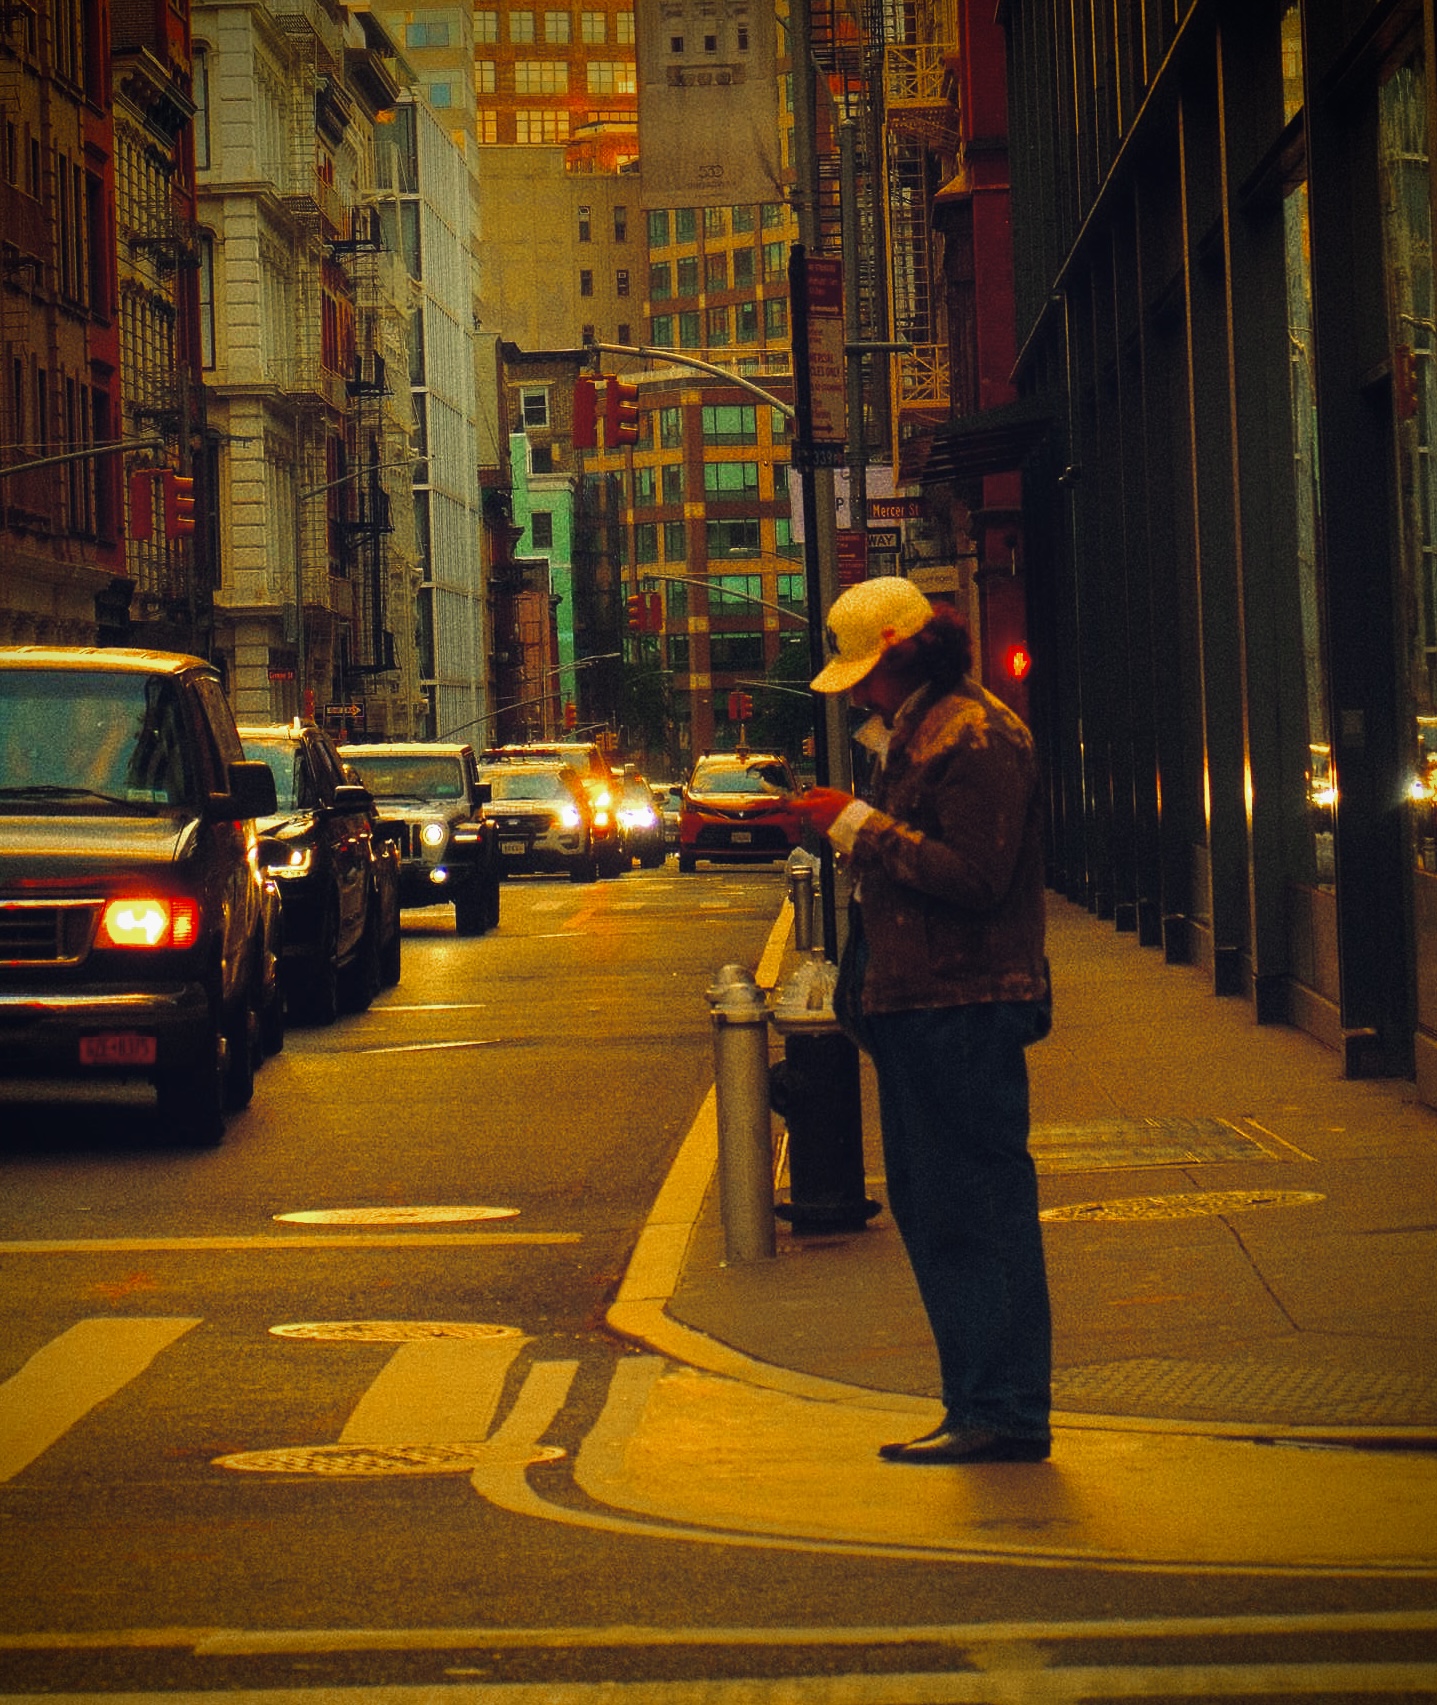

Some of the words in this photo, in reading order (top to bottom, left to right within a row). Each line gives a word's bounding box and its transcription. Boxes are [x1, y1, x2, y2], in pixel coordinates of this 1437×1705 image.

[873, 504, 904, 518] Mercer
[908, 503, 919, 517] St
[867, 535, 893, 546] WAY
